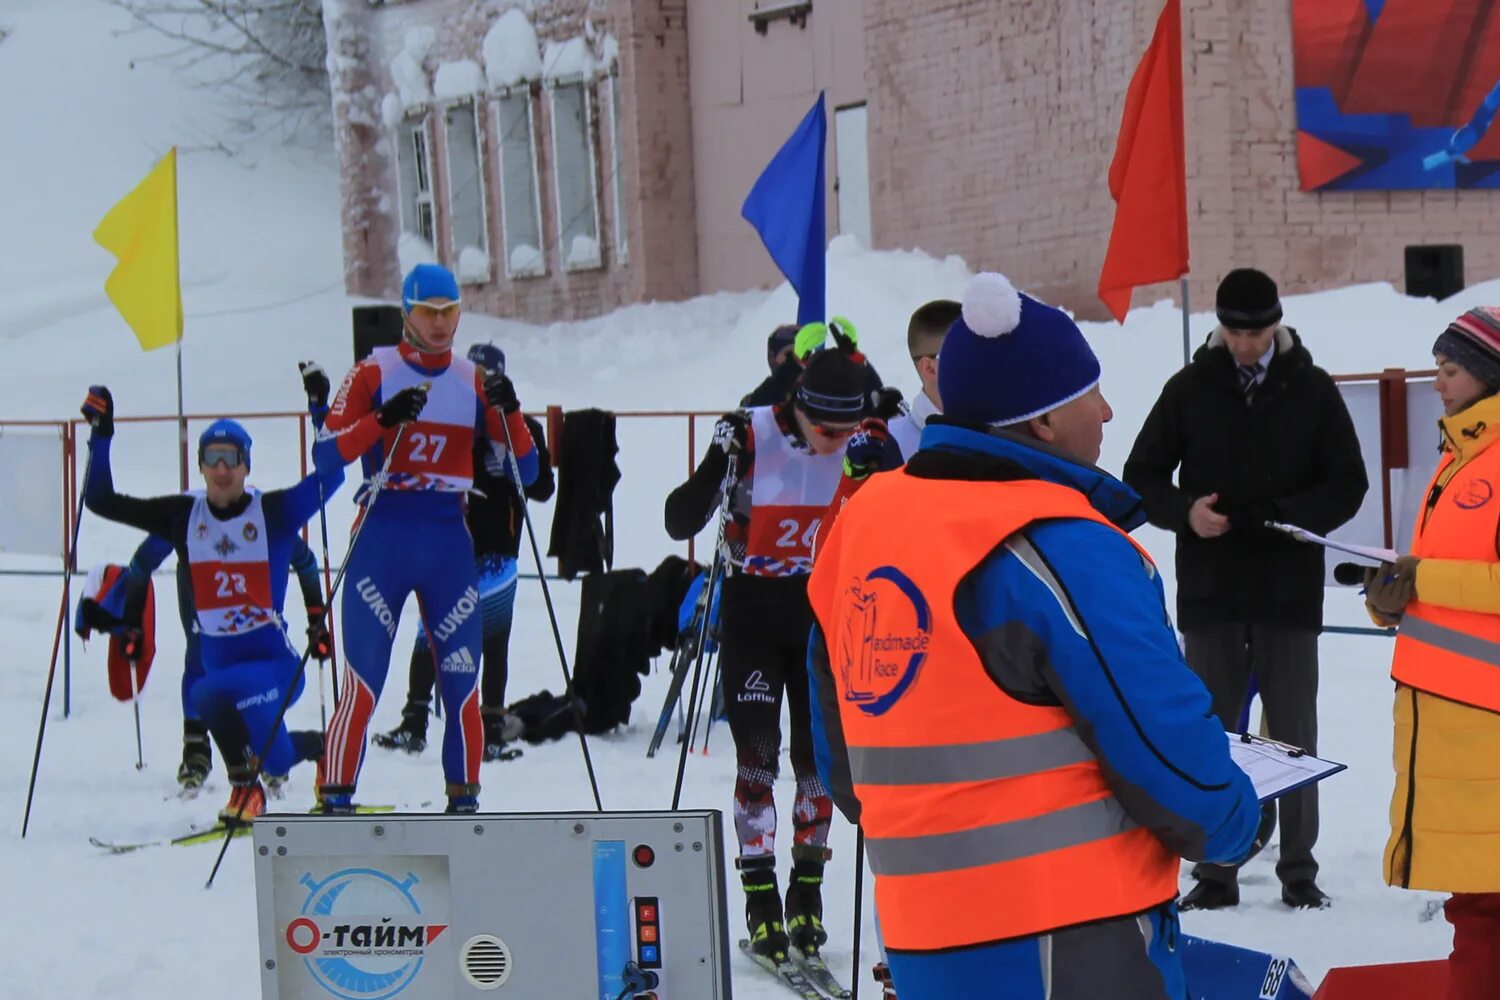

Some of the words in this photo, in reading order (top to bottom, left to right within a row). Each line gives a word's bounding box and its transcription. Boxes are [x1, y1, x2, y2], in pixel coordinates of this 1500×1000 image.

[409, 432, 447, 464] 27
[434, 585, 479, 643] LUKOIL
[1262, 958, 1286, 996] 68
